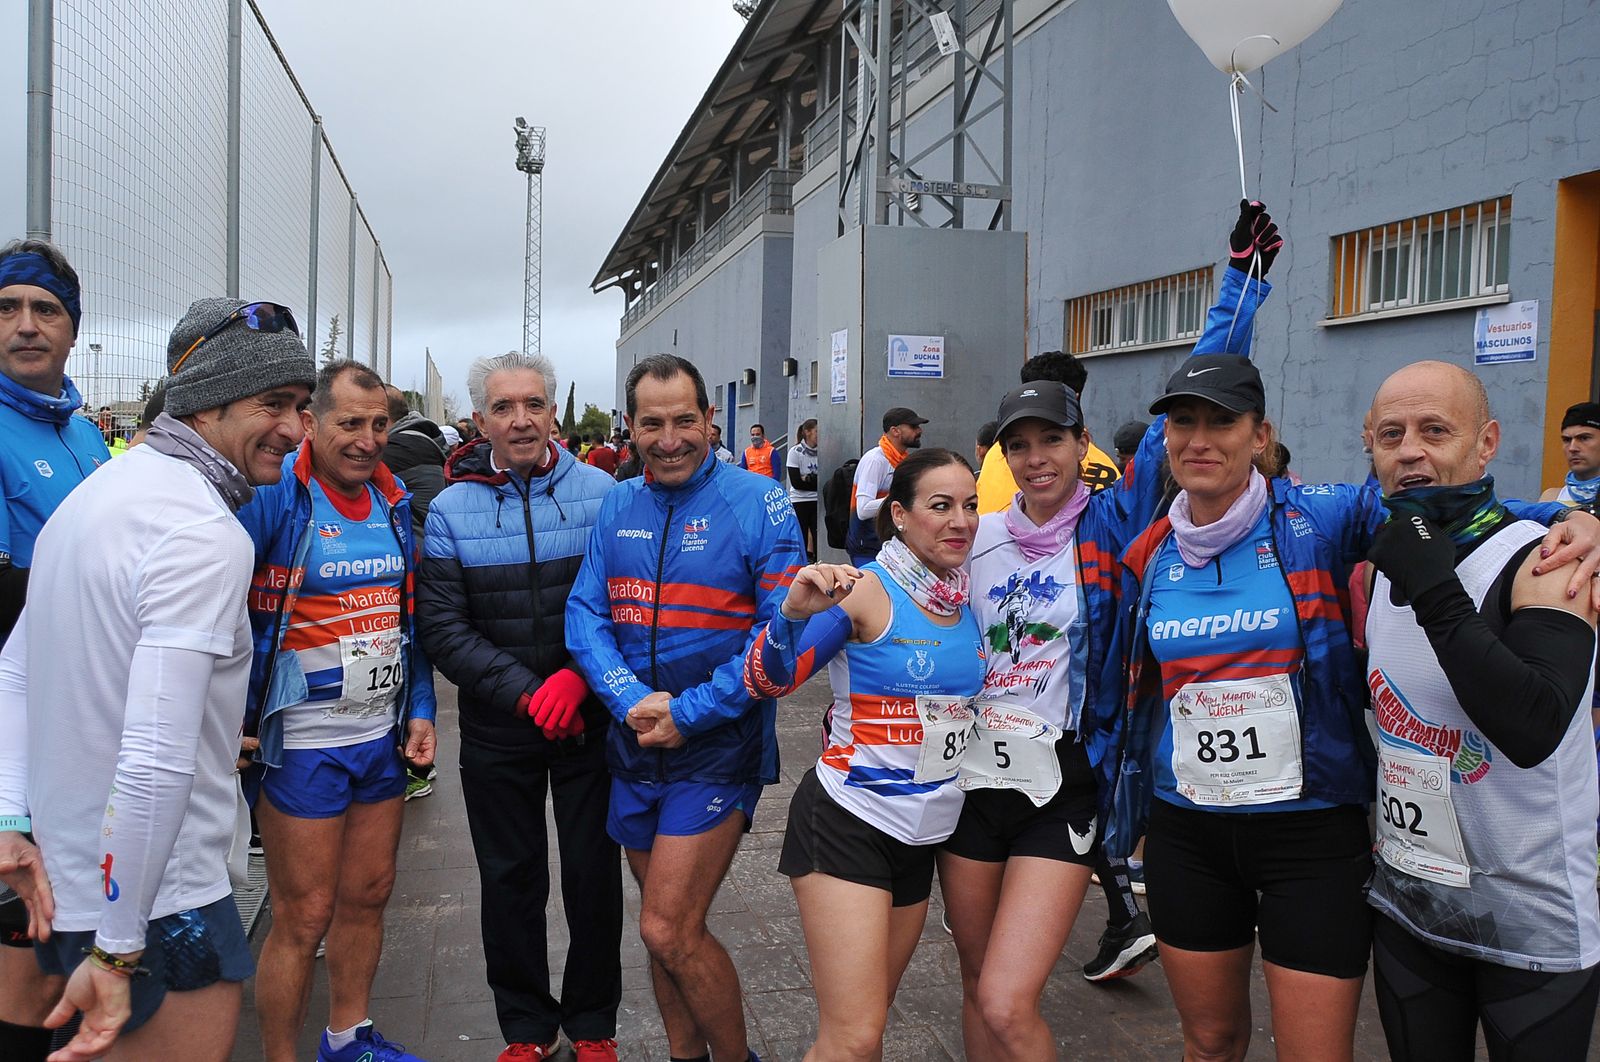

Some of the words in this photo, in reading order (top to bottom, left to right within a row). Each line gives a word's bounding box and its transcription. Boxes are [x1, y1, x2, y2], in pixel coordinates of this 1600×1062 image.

[1487, 321, 1532, 333] Vestuarios
[923, 345, 940, 353] Zona
[1476, 336, 1532, 349] MASCULINOS
[617, 529, 653, 539] enerplus
[1295, 527, 1314, 538] Luce
[337, 588, 400, 611] Maratón
[1152, 608, 1280, 640] enerplus
[367, 662, 400, 691] 120
[603, 666, 629, 684] Club
[1378, 686, 1409, 723] MEDIA
[887, 725, 923, 742] Luc
[1197, 726, 1267, 763] 831
[993, 741, 1011, 769] 5
[1454, 745, 1482, 772] 2023
[1461, 773, 1469, 784] 5
[1468, 761, 1491, 784] MARZO
[1381, 787, 1428, 837] 502
